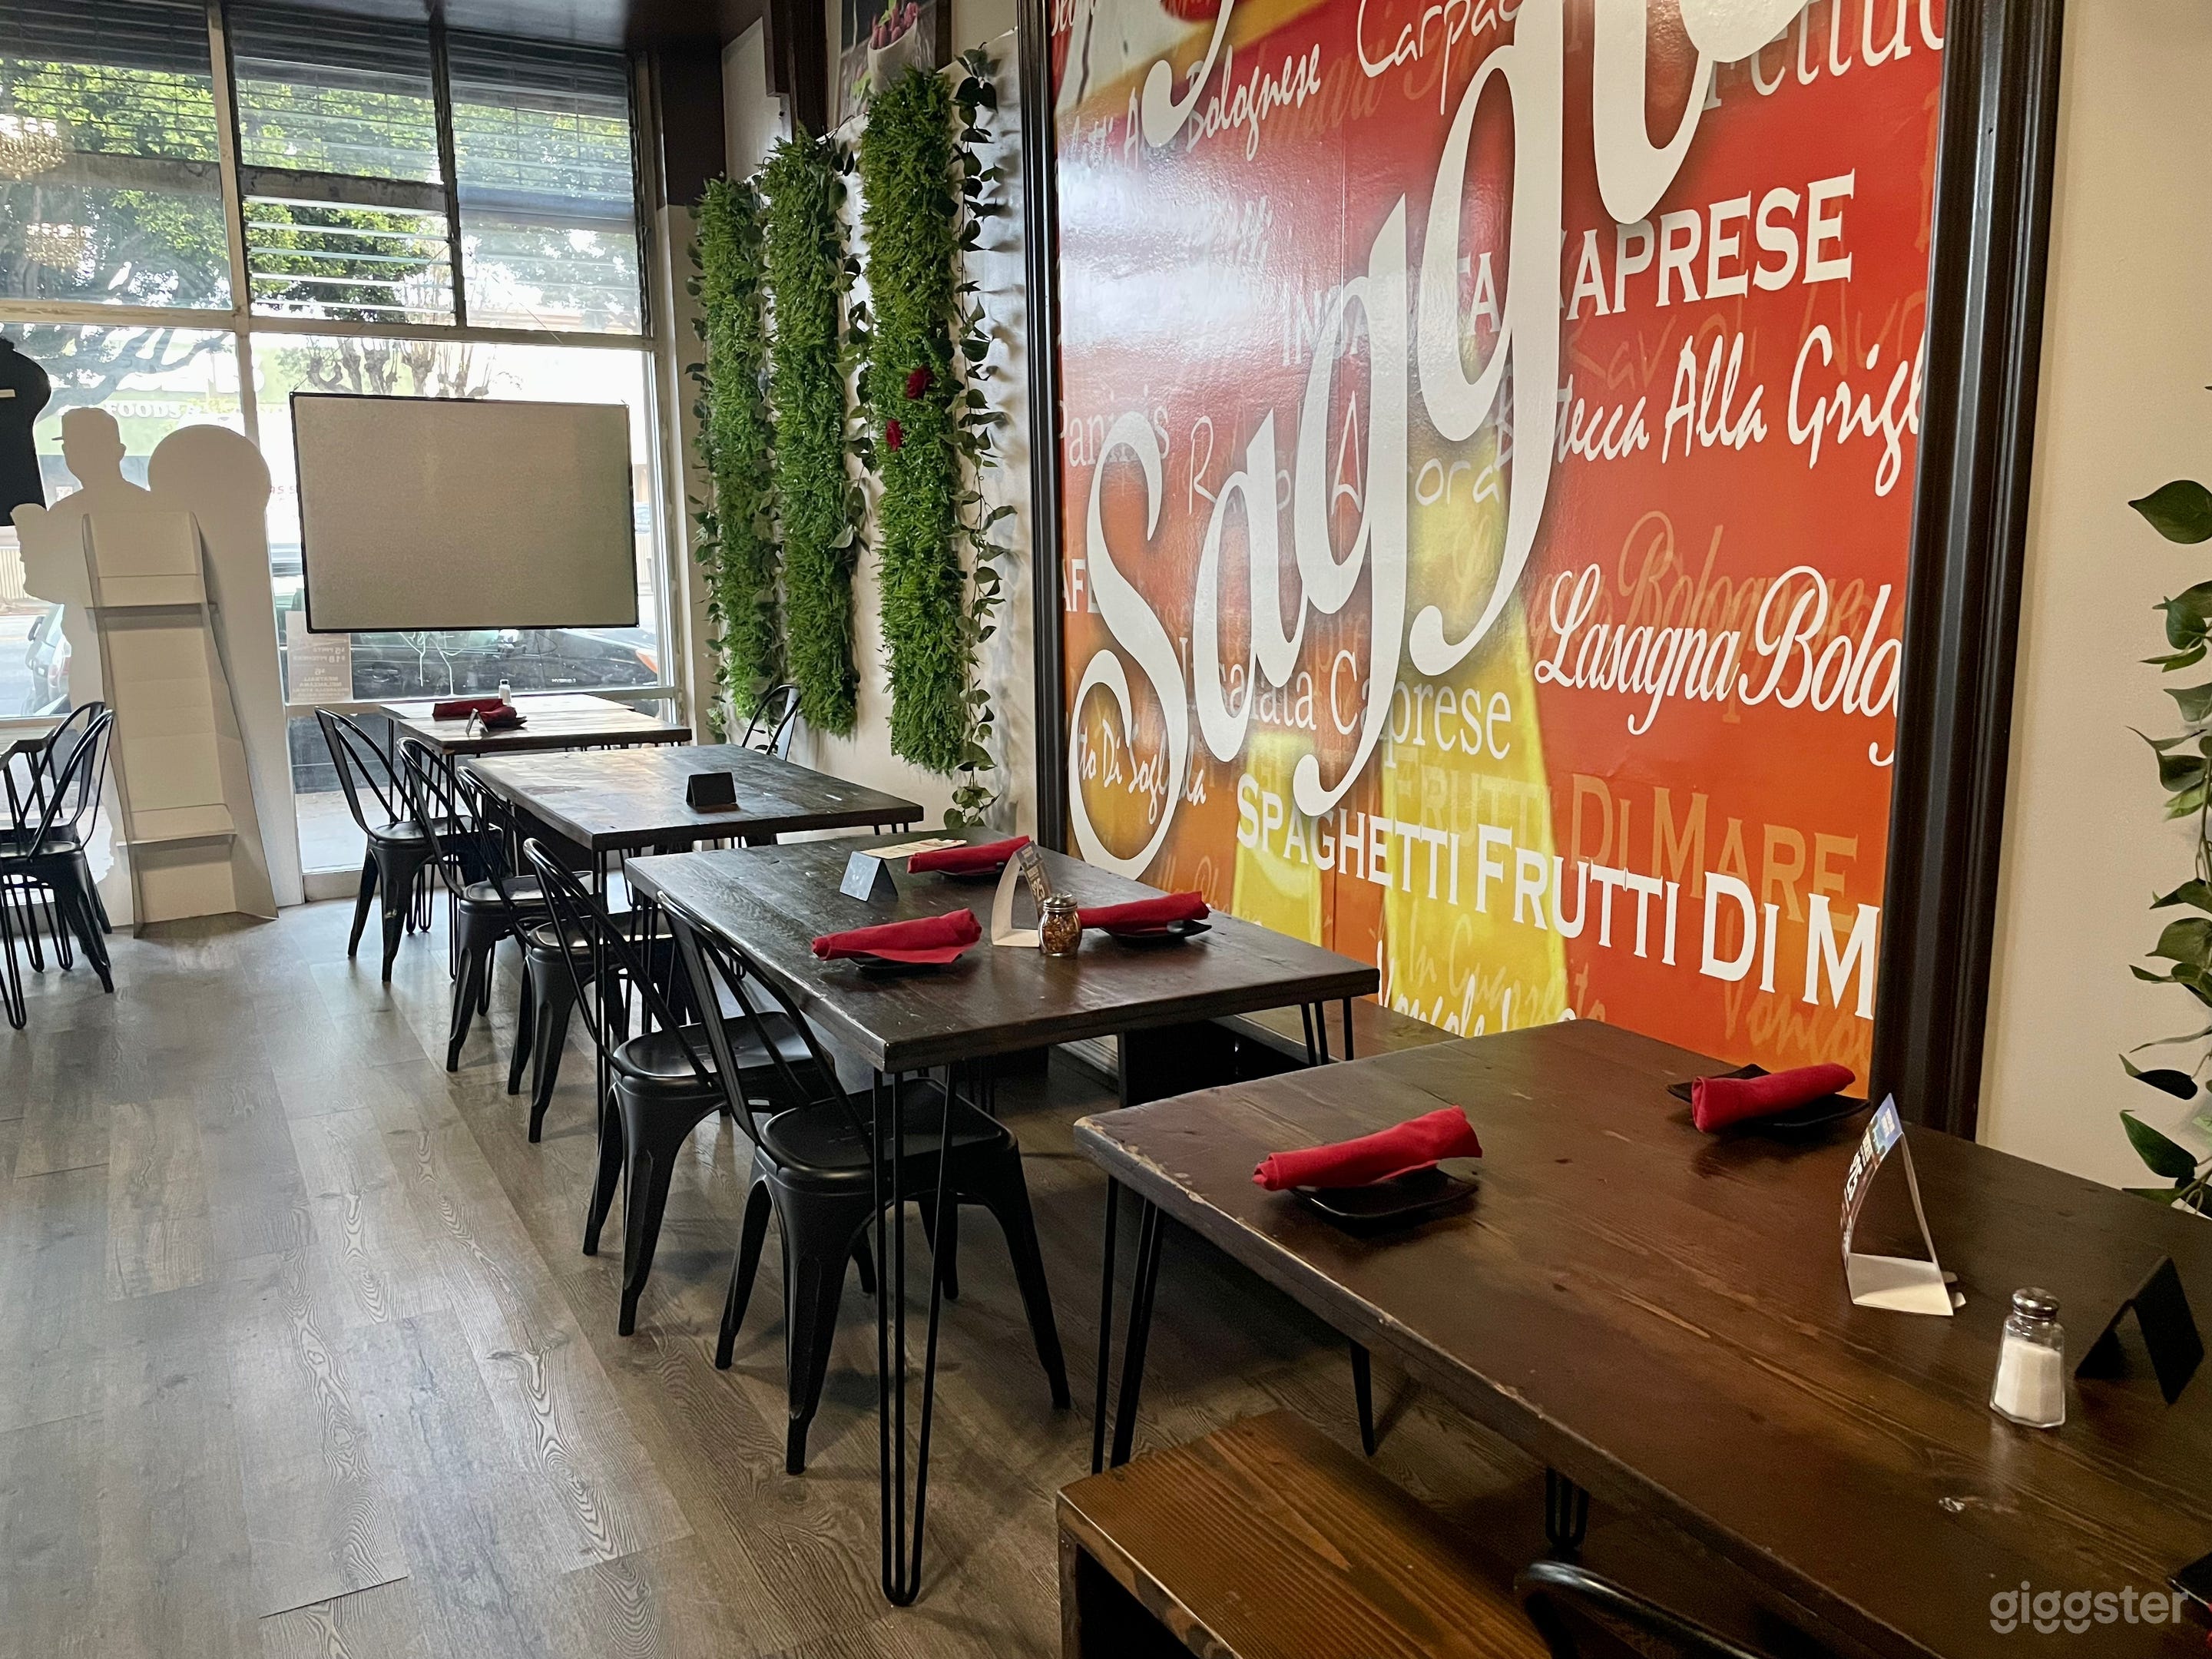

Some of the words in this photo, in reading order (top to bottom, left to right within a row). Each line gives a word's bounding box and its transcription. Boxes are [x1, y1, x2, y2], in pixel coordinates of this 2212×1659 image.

[1558, 169, 1855, 321] APRESE
[1661, 335, 1767, 464] Alla
[1534, 563, 1740, 735] Lasagna
[1237, 772, 1461, 906] SPAGHETTI
[1475, 823, 1680, 965] FRUTTI
[1700, 871, 1780, 993] DI
